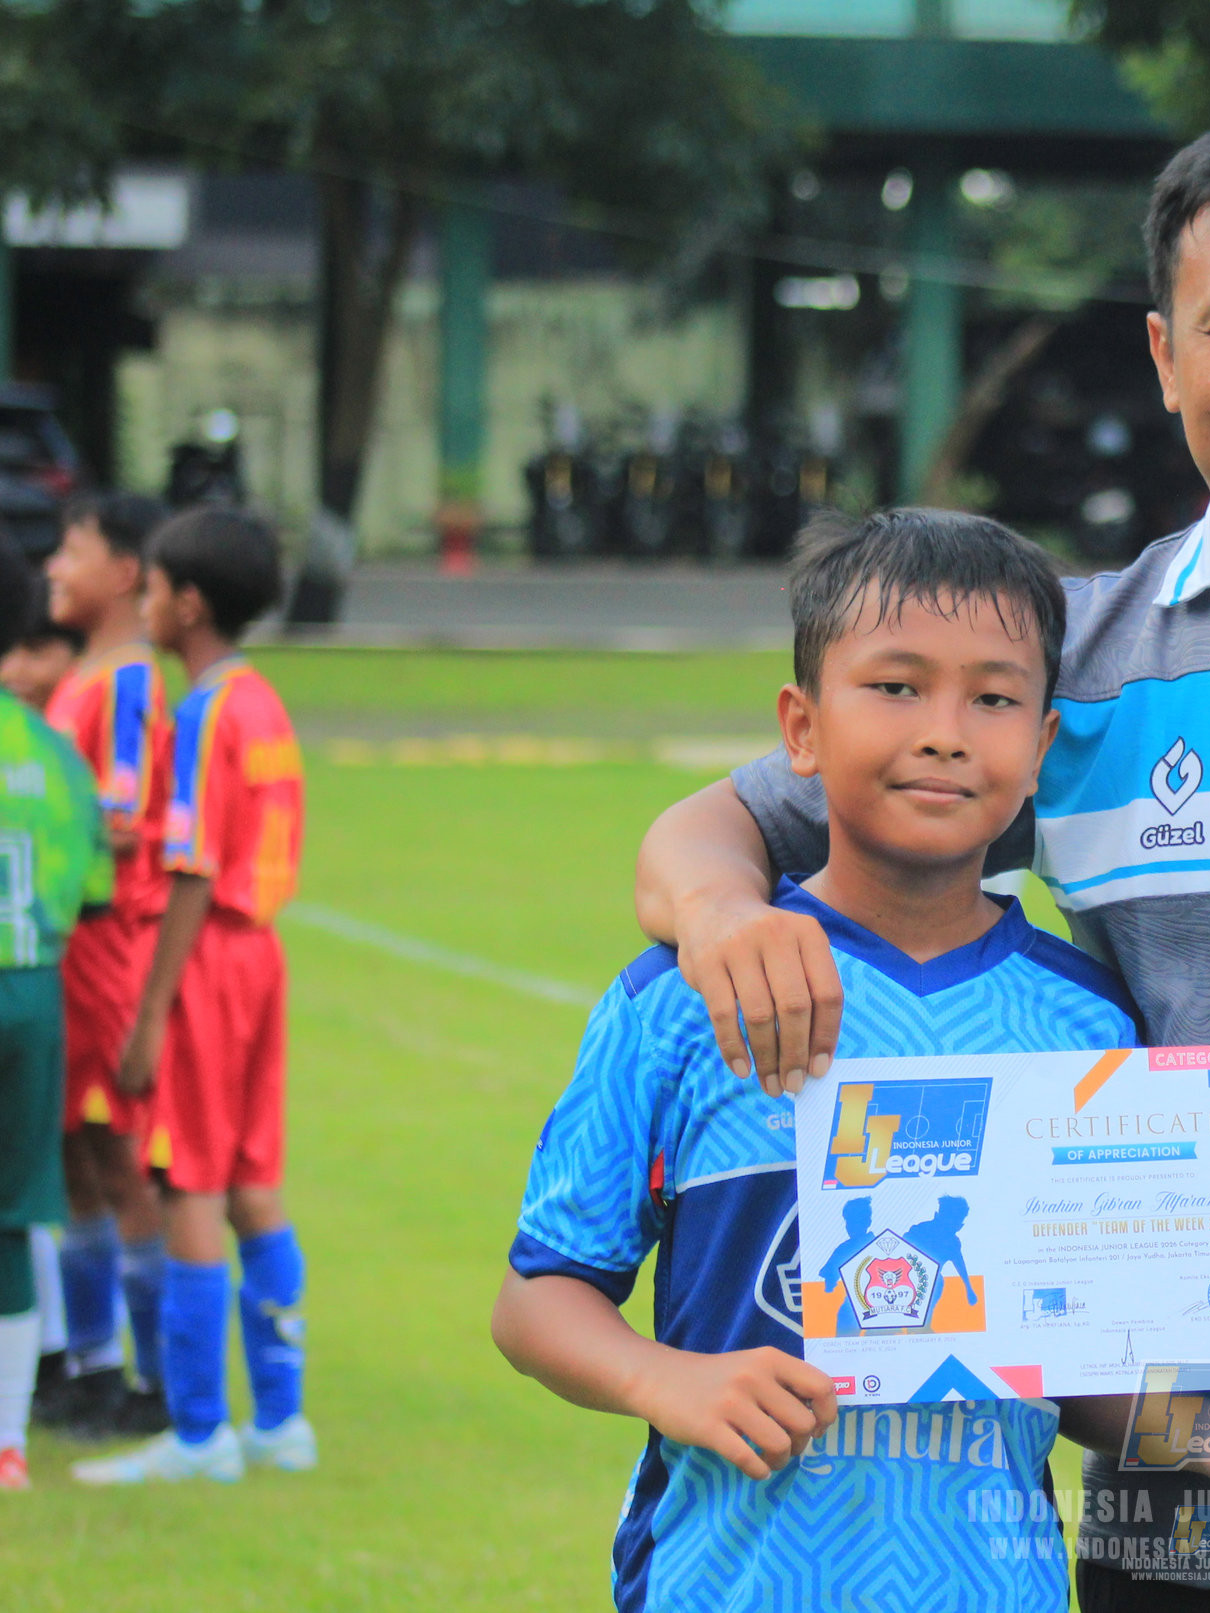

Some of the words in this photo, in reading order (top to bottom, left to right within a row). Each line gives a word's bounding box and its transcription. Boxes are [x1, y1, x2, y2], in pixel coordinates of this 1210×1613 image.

[1140, 821, 1205, 849] Güzel
[893, 1140, 940, 1150] INDONESIA
[941, 1139, 972, 1148] JUNIOR
[1067, 1150, 1083, 1161] OF
[1088, 1146, 1181, 1161] APPRECIATION
[868, 1147, 973, 1180] League
[1032, 1222, 1088, 1237] DEFENDER
[1133, 1219, 1147, 1233] OF
[1151, 1218, 1171, 1232] THE
[1174, 1216, 1205, 1231] WEEK
[1058, 1244, 1099, 1252] INDONESIA
[1101, 1242, 1128, 1251] JUNIOR
[1130, 1241, 1159, 1250] LEAGUE
[871, 1291, 882, 1299] 19
[870, 1304, 899, 1313] MUTIARA
